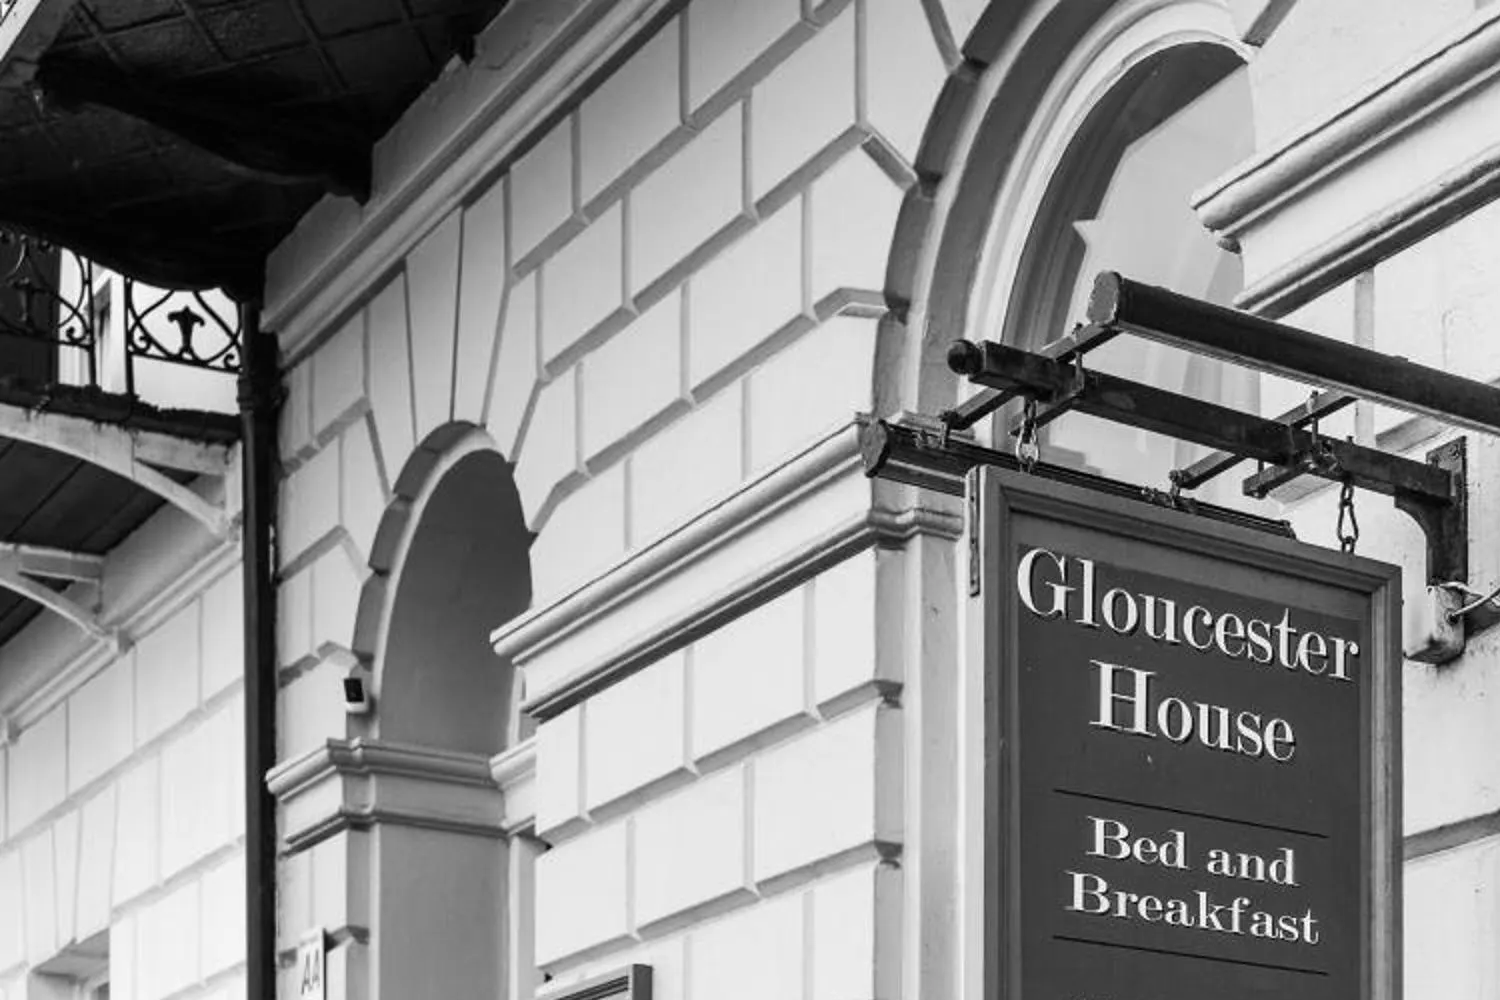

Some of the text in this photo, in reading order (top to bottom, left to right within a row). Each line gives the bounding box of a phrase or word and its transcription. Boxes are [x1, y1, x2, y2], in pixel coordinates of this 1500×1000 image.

[1017, 547, 1359, 682] Gloucester
[1088, 659, 1297, 762] House
[1086, 815, 1300, 887] Bed and
[1064, 870, 1319, 945] Breakfast
